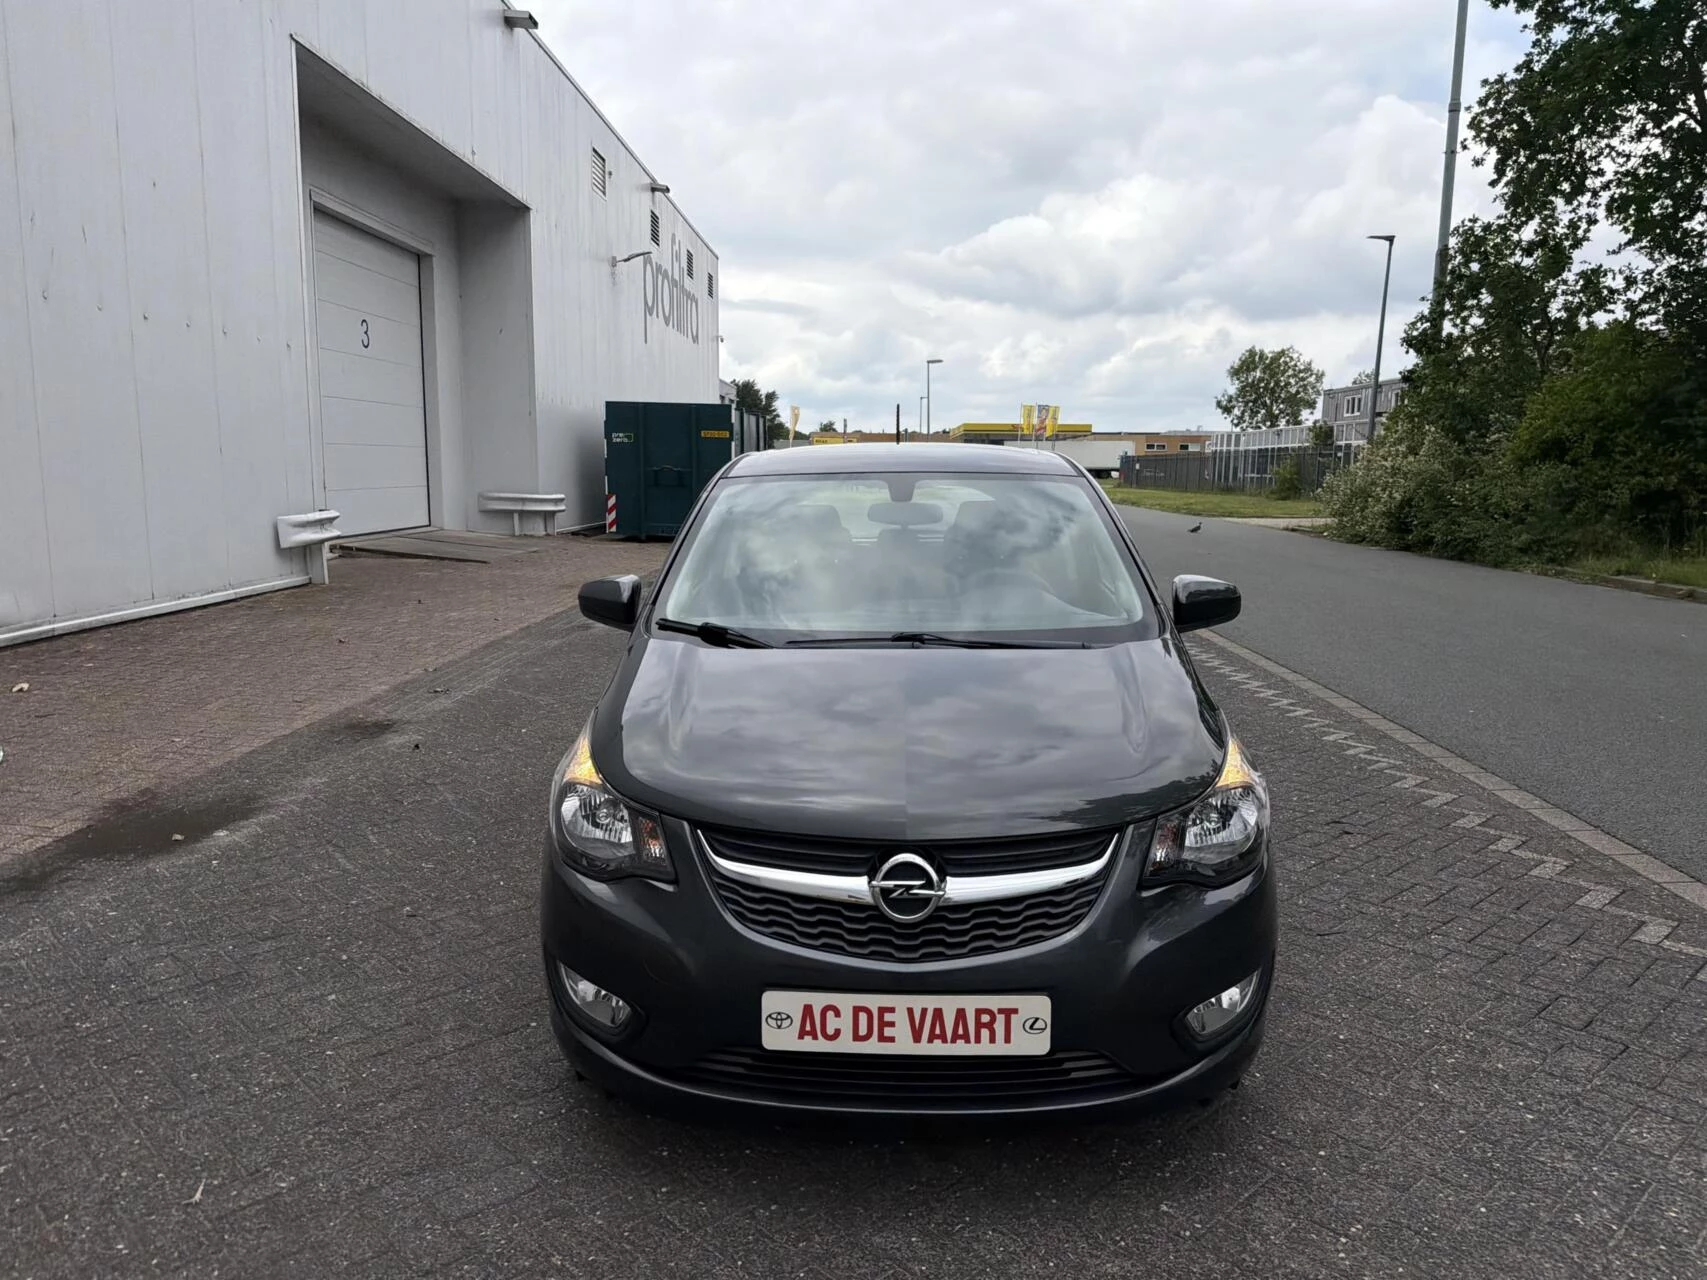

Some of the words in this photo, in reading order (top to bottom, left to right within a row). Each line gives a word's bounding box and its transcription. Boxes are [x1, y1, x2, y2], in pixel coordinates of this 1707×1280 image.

[360, 318, 370, 349] 3
[797, 1003, 842, 1042] AC
[851, 1005, 897, 1044] DE
[906, 1007, 1019, 1045] VAART
